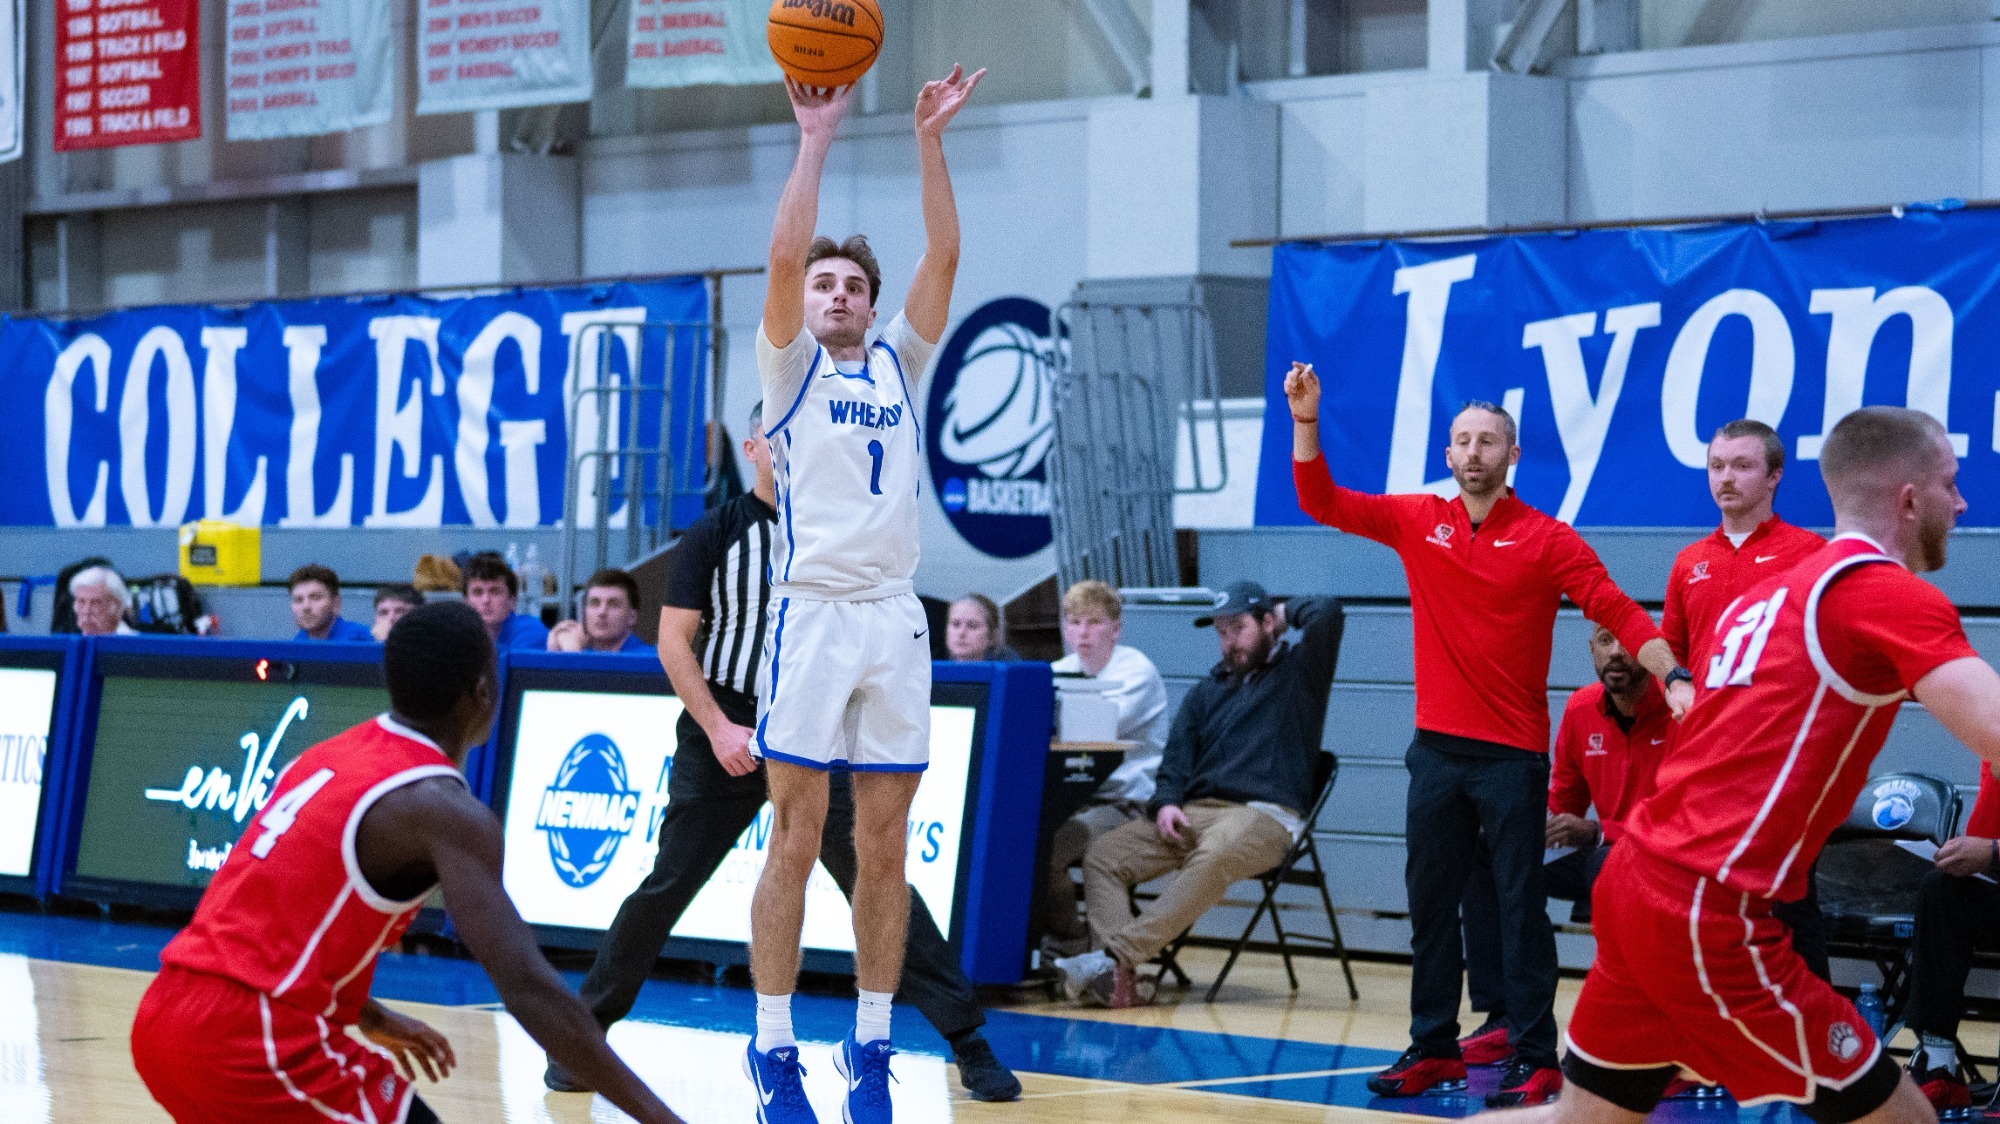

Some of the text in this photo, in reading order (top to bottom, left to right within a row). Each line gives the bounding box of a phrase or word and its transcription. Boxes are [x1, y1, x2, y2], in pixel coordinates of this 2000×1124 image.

[45, 307, 646, 528] COLLEGE
[829, 400, 903, 430] WHEAO
[1385, 254, 2000, 526] Lyon
[867, 439, 884, 495] 1
[967, 478, 1052, 516] BASKETBA
[1705, 586, 1789, 689] 31
[0, 734, 48, 785] TICS
[251, 768, 335, 859] 4
[538, 789, 638, 833] NEWMAC
